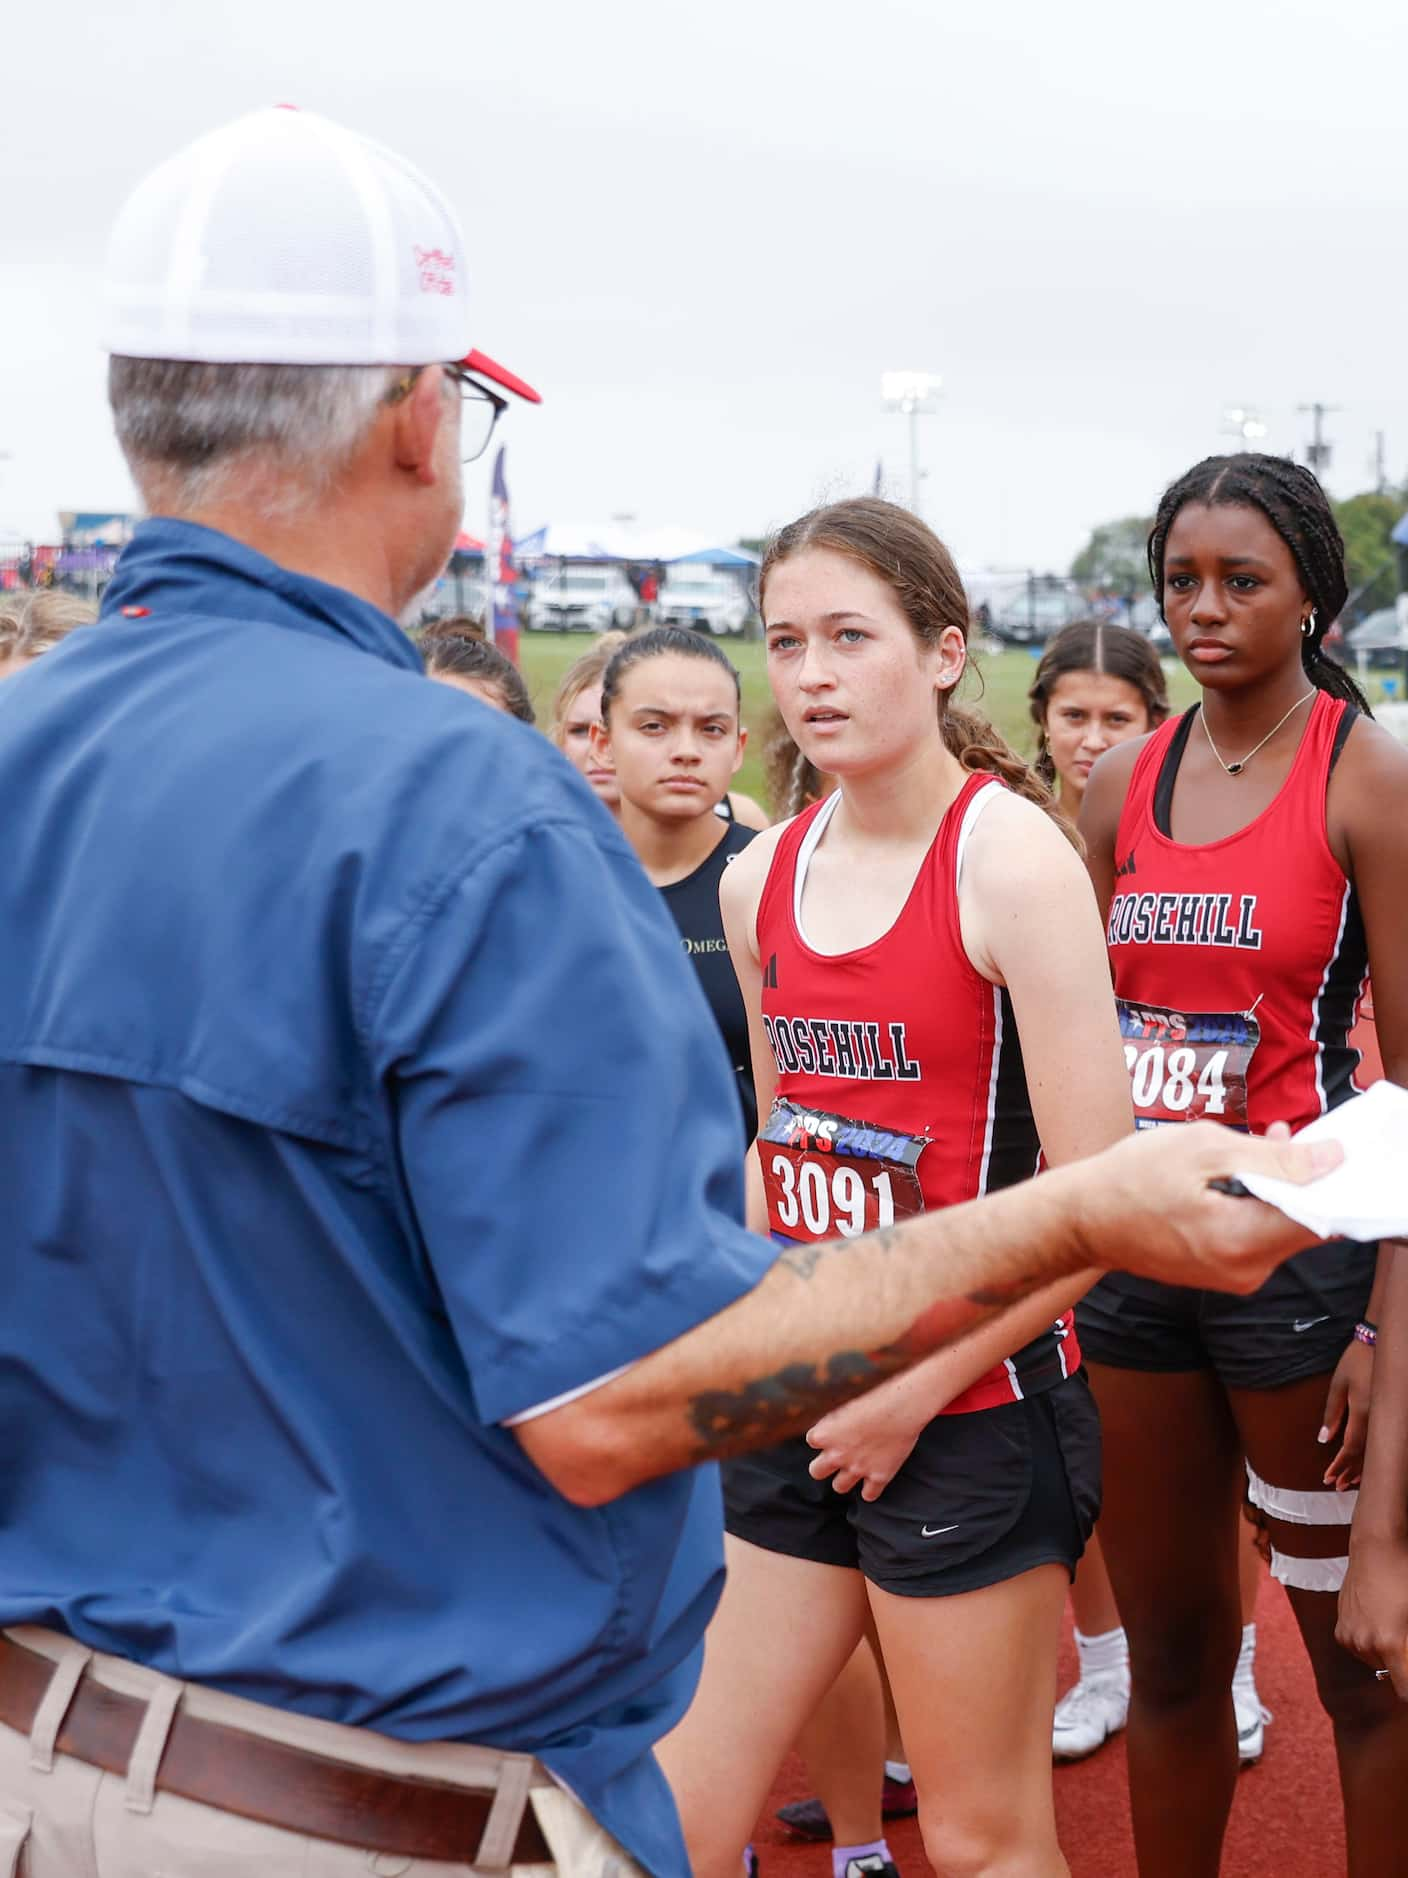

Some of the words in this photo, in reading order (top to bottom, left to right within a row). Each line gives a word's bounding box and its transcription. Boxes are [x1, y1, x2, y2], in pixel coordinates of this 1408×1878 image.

[681, 938, 728, 953] OMEG
[1108, 893, 1262, 950] ROSEHILL
[772, 1154, 894, 1239] 3091
